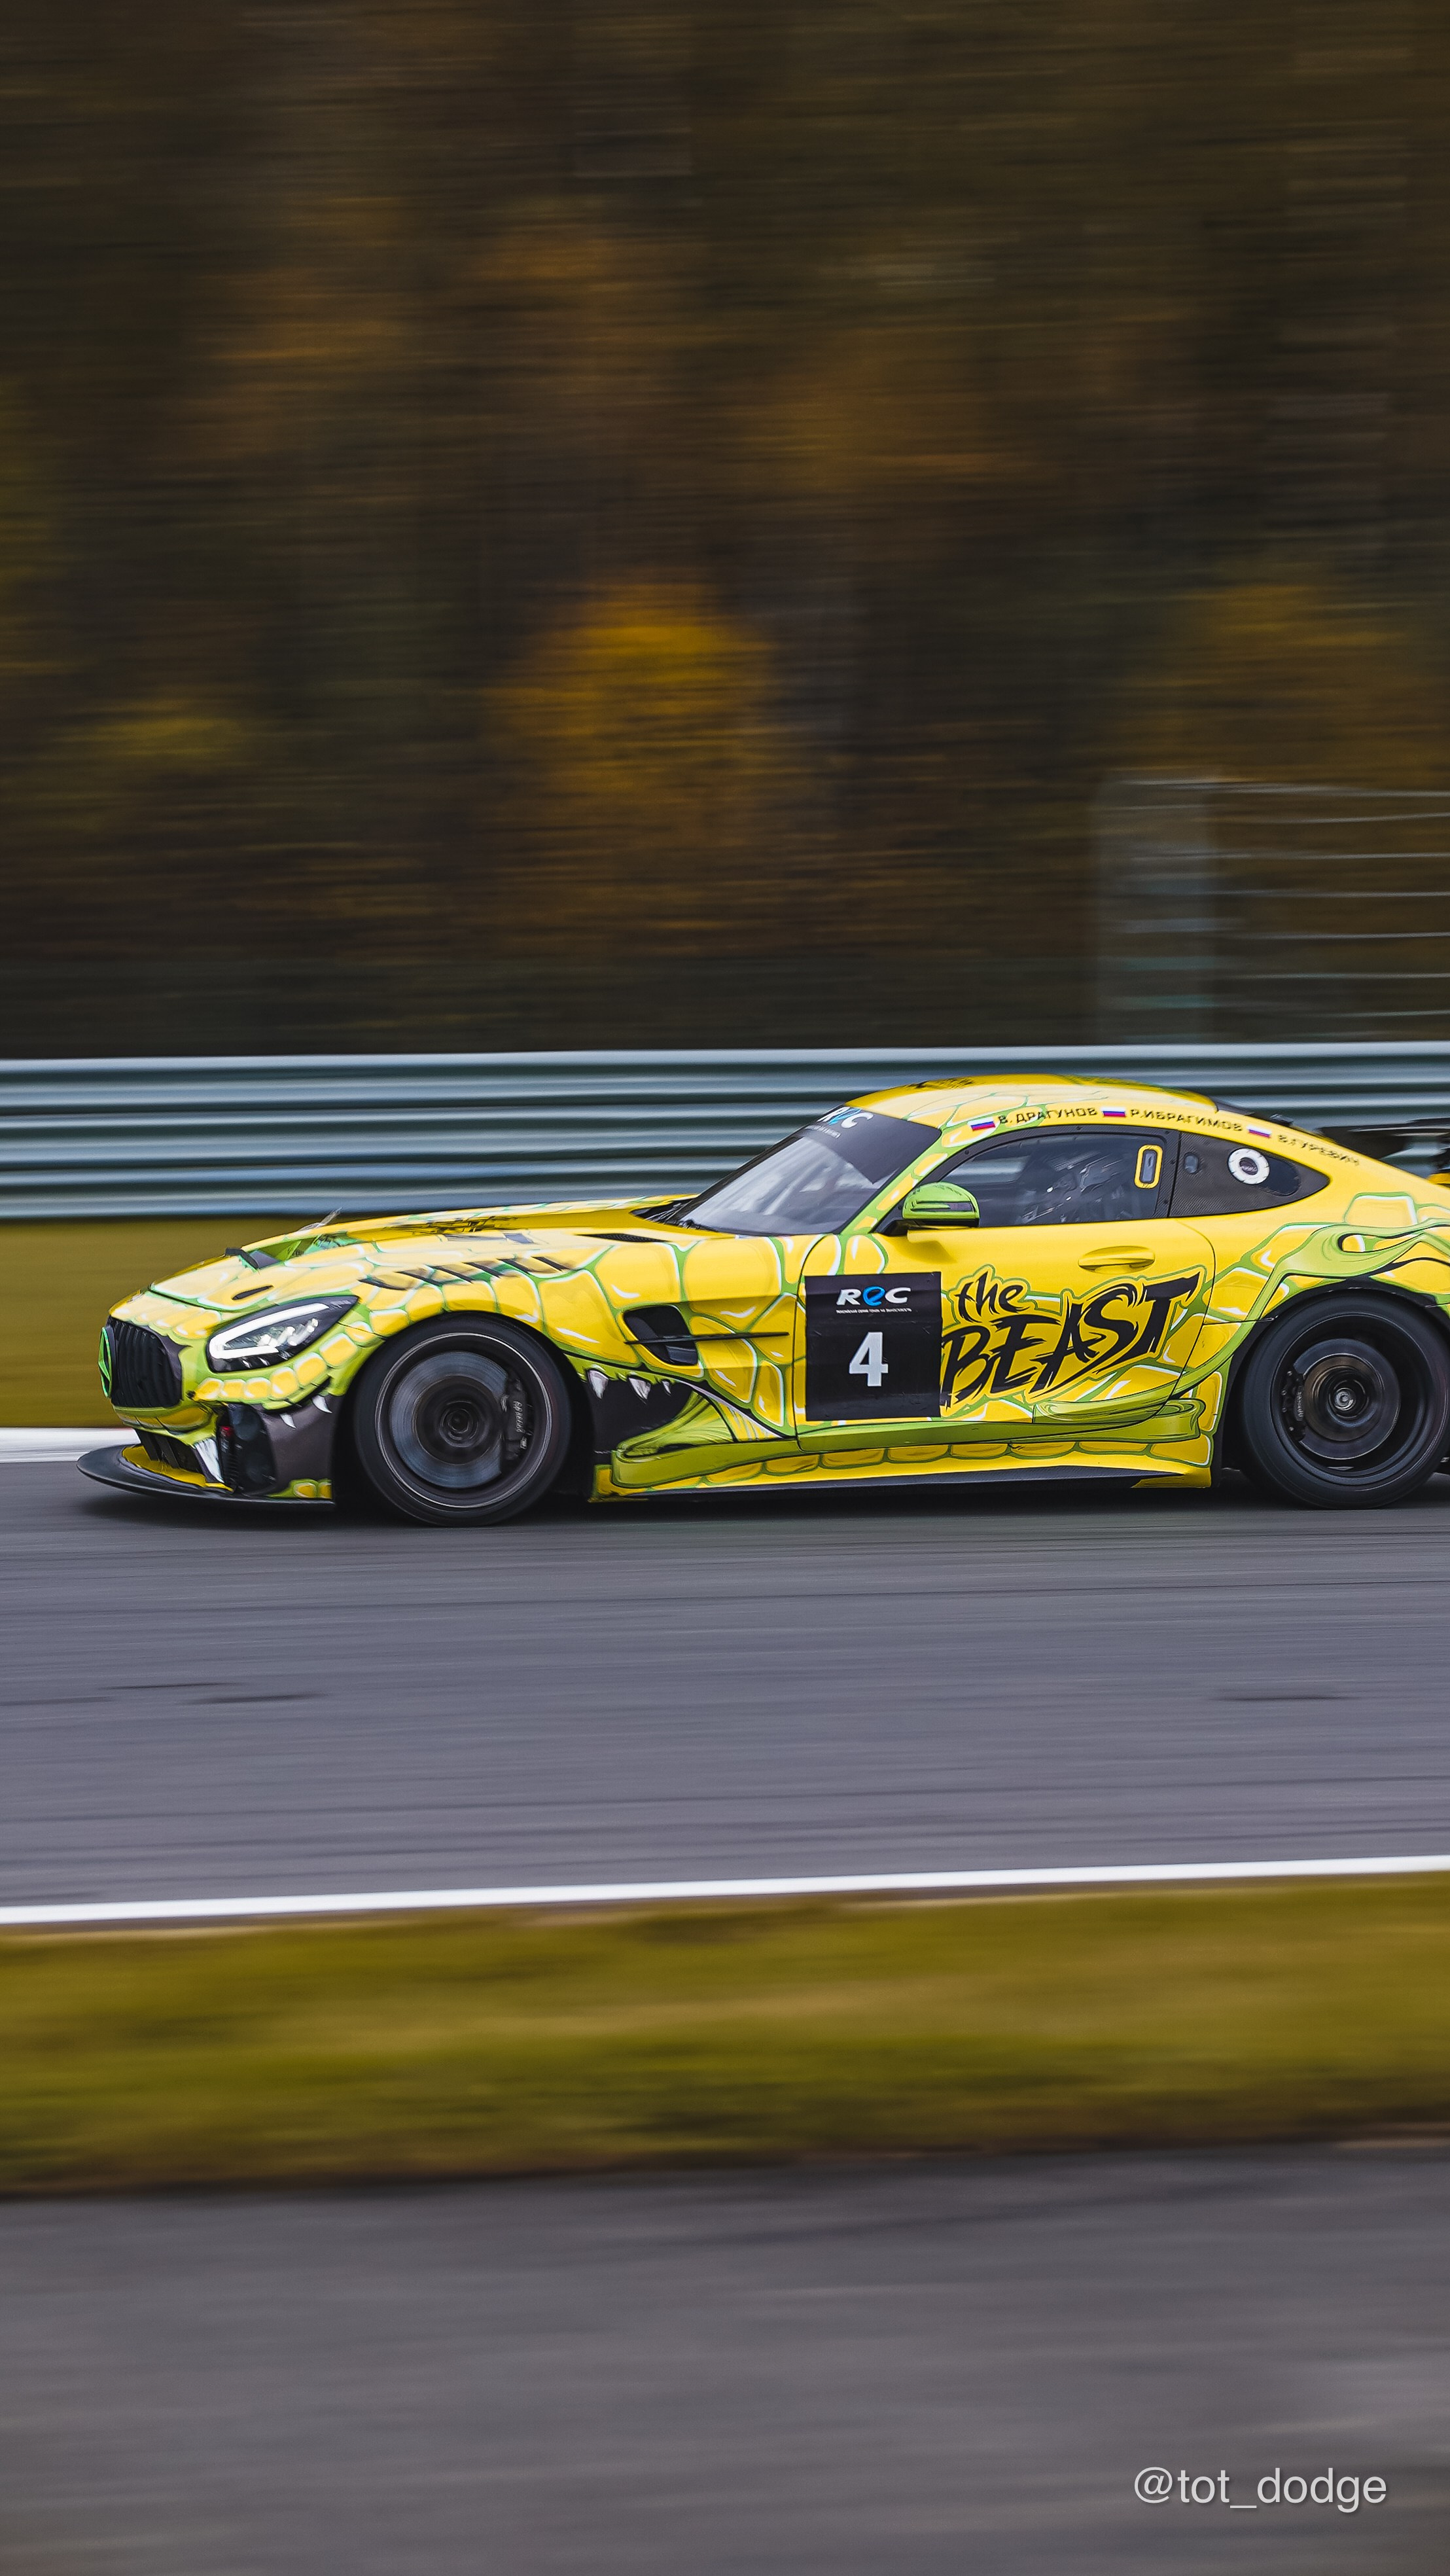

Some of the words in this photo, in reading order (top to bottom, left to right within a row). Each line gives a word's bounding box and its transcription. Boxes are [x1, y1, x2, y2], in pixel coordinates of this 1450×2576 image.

[1016, 1107, 1097, 1124] ДРАГУНОВ
[954, 1271, 1029, 1323] the
[849, 1331, 889, 1386] 4
[940, 1272, 1201, 1408] BEAST
